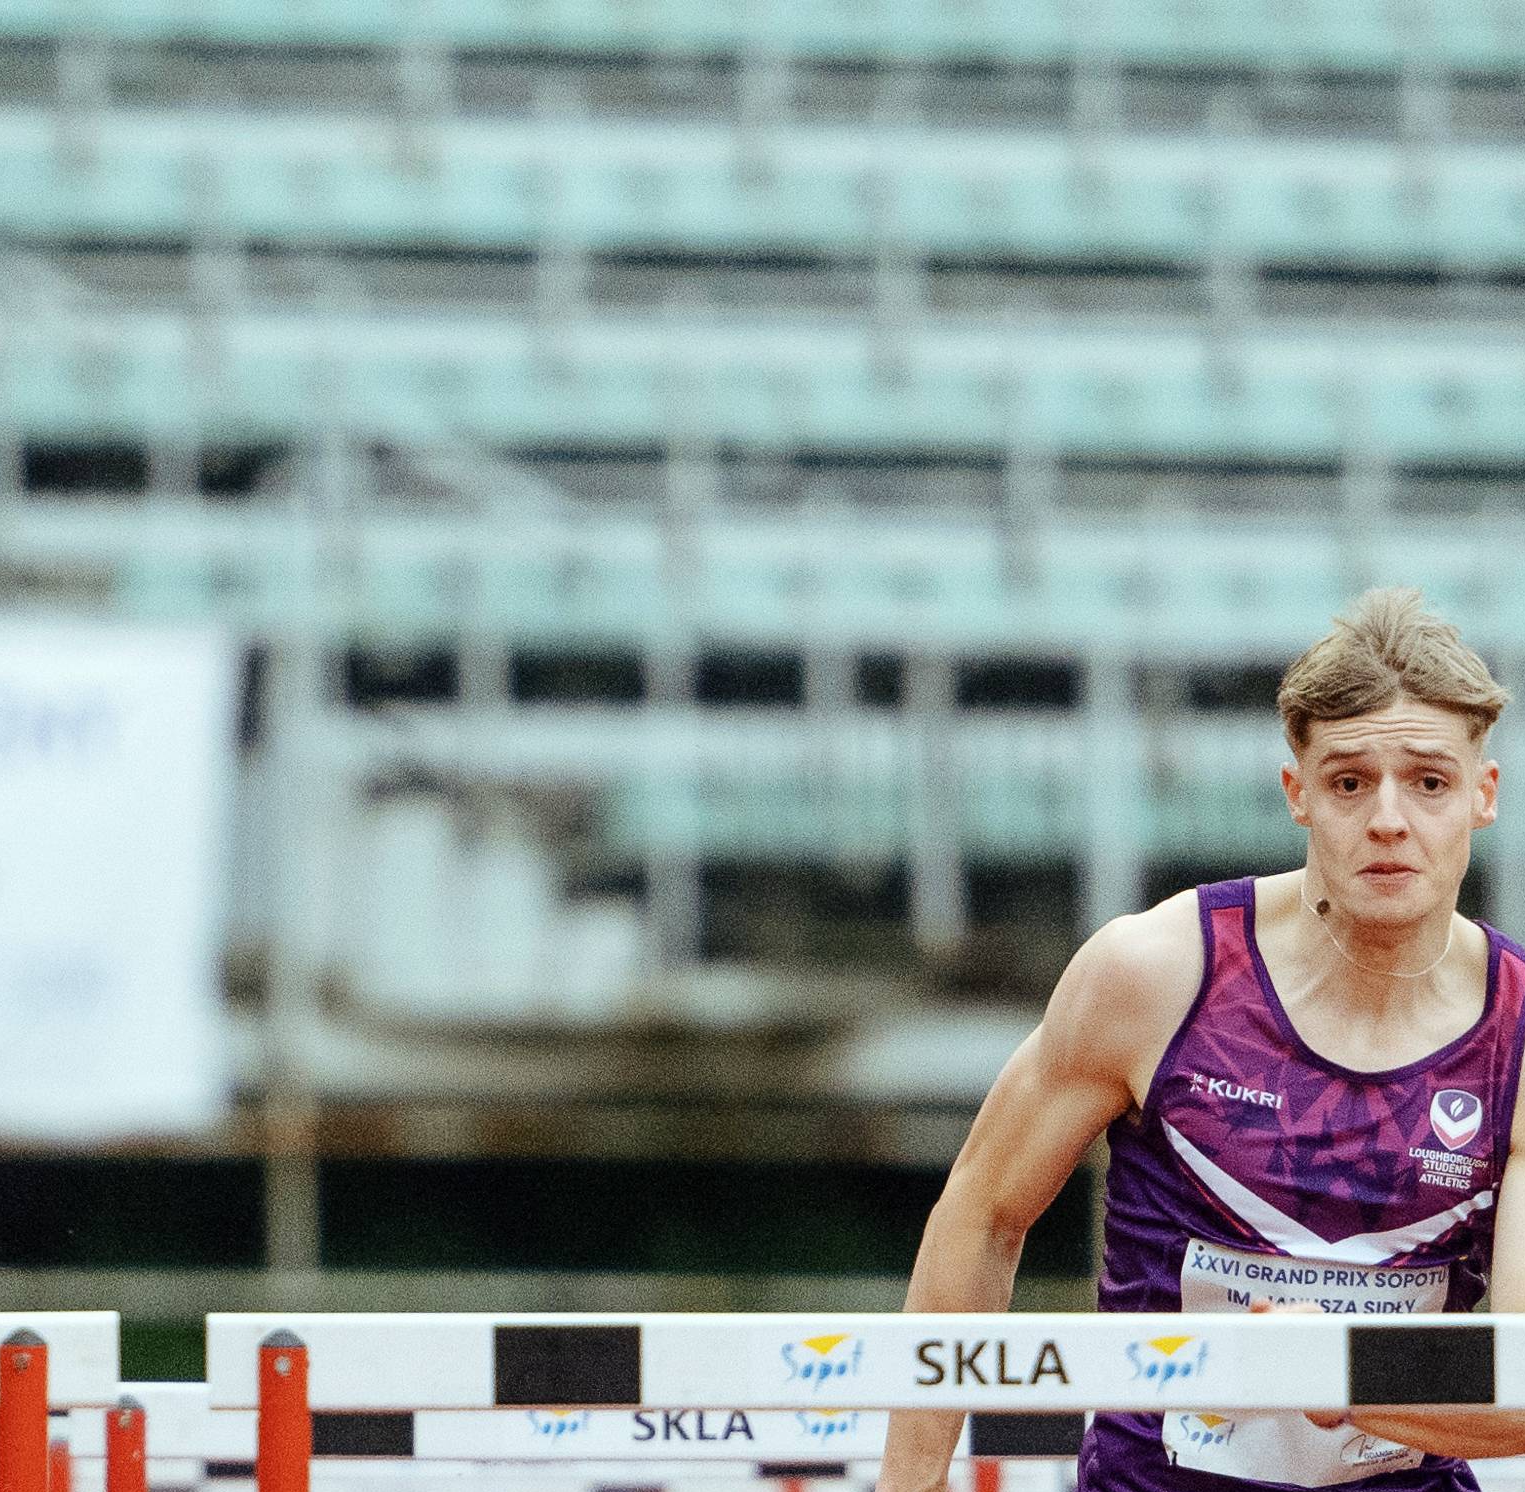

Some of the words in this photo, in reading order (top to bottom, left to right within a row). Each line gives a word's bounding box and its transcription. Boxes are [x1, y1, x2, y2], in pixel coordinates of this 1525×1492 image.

[1208, 1078, 1283, 1109] KUKRI
[1418, 1173, 1471, 1190] ATHLETICS
[1422, 1159, 1473, 1176] STUDENTS
[1191, 1253, 1240, 1276] XXVI
[1245, 1264, 1318, 1285] GRAND
[1323, 1270, 1369, 1288] PRIX
[1375, 1270, 1446, 1289] SOPOTU
[1227, 1288, 1251, 1307] IM
[779, 1340, 866, 1393] Sopot
[915, 1339, 1071, 1387] SKLA
[1124, 1340, 1209, 1393] Sopot
[632, 1410, 755, 1441] SKLA
[1180, 1413, 1236, 1453] Sopot
